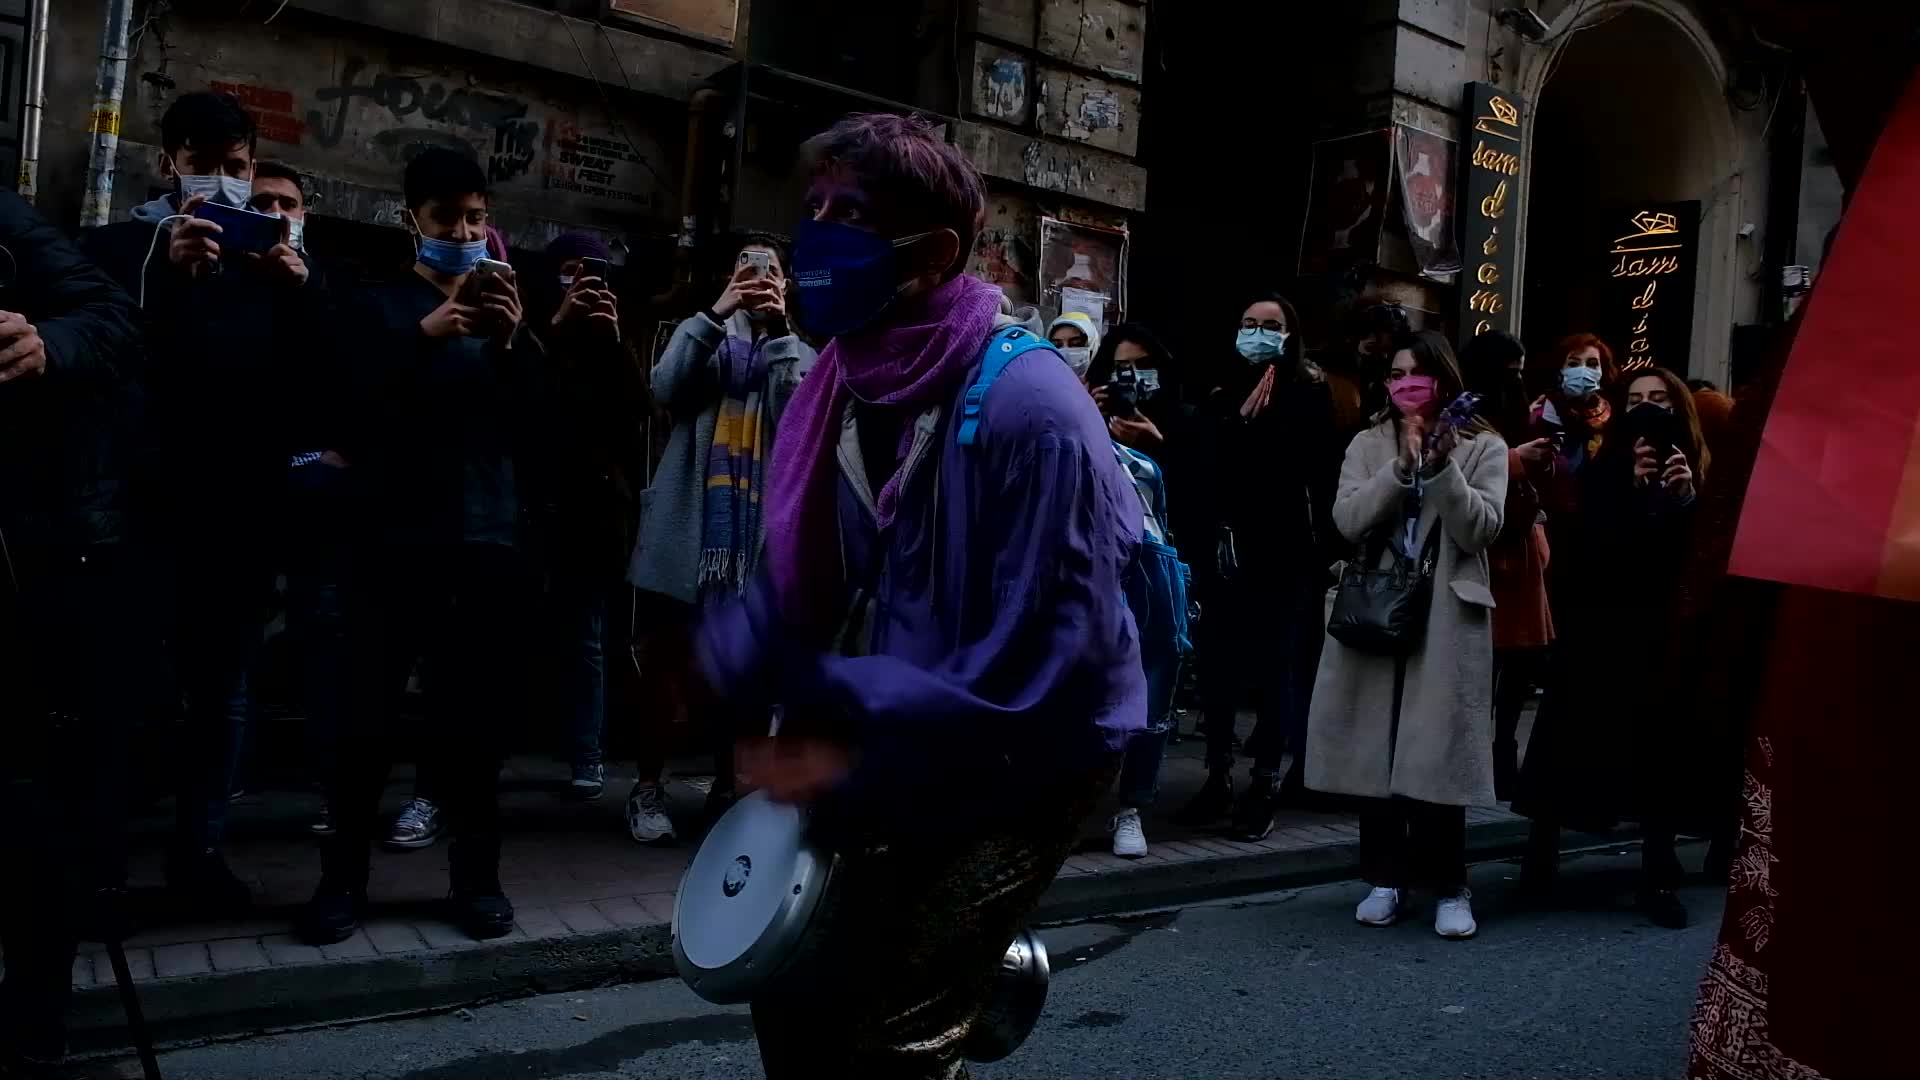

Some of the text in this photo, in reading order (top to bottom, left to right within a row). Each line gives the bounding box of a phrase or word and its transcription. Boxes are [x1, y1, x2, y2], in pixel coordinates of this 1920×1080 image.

[559, 151, 615, 172] SWEAT
[1472, 140, 1520, 175] sam
[577, 169, 617, 185] FEST
[1610, 255, 1679, 278] sam
